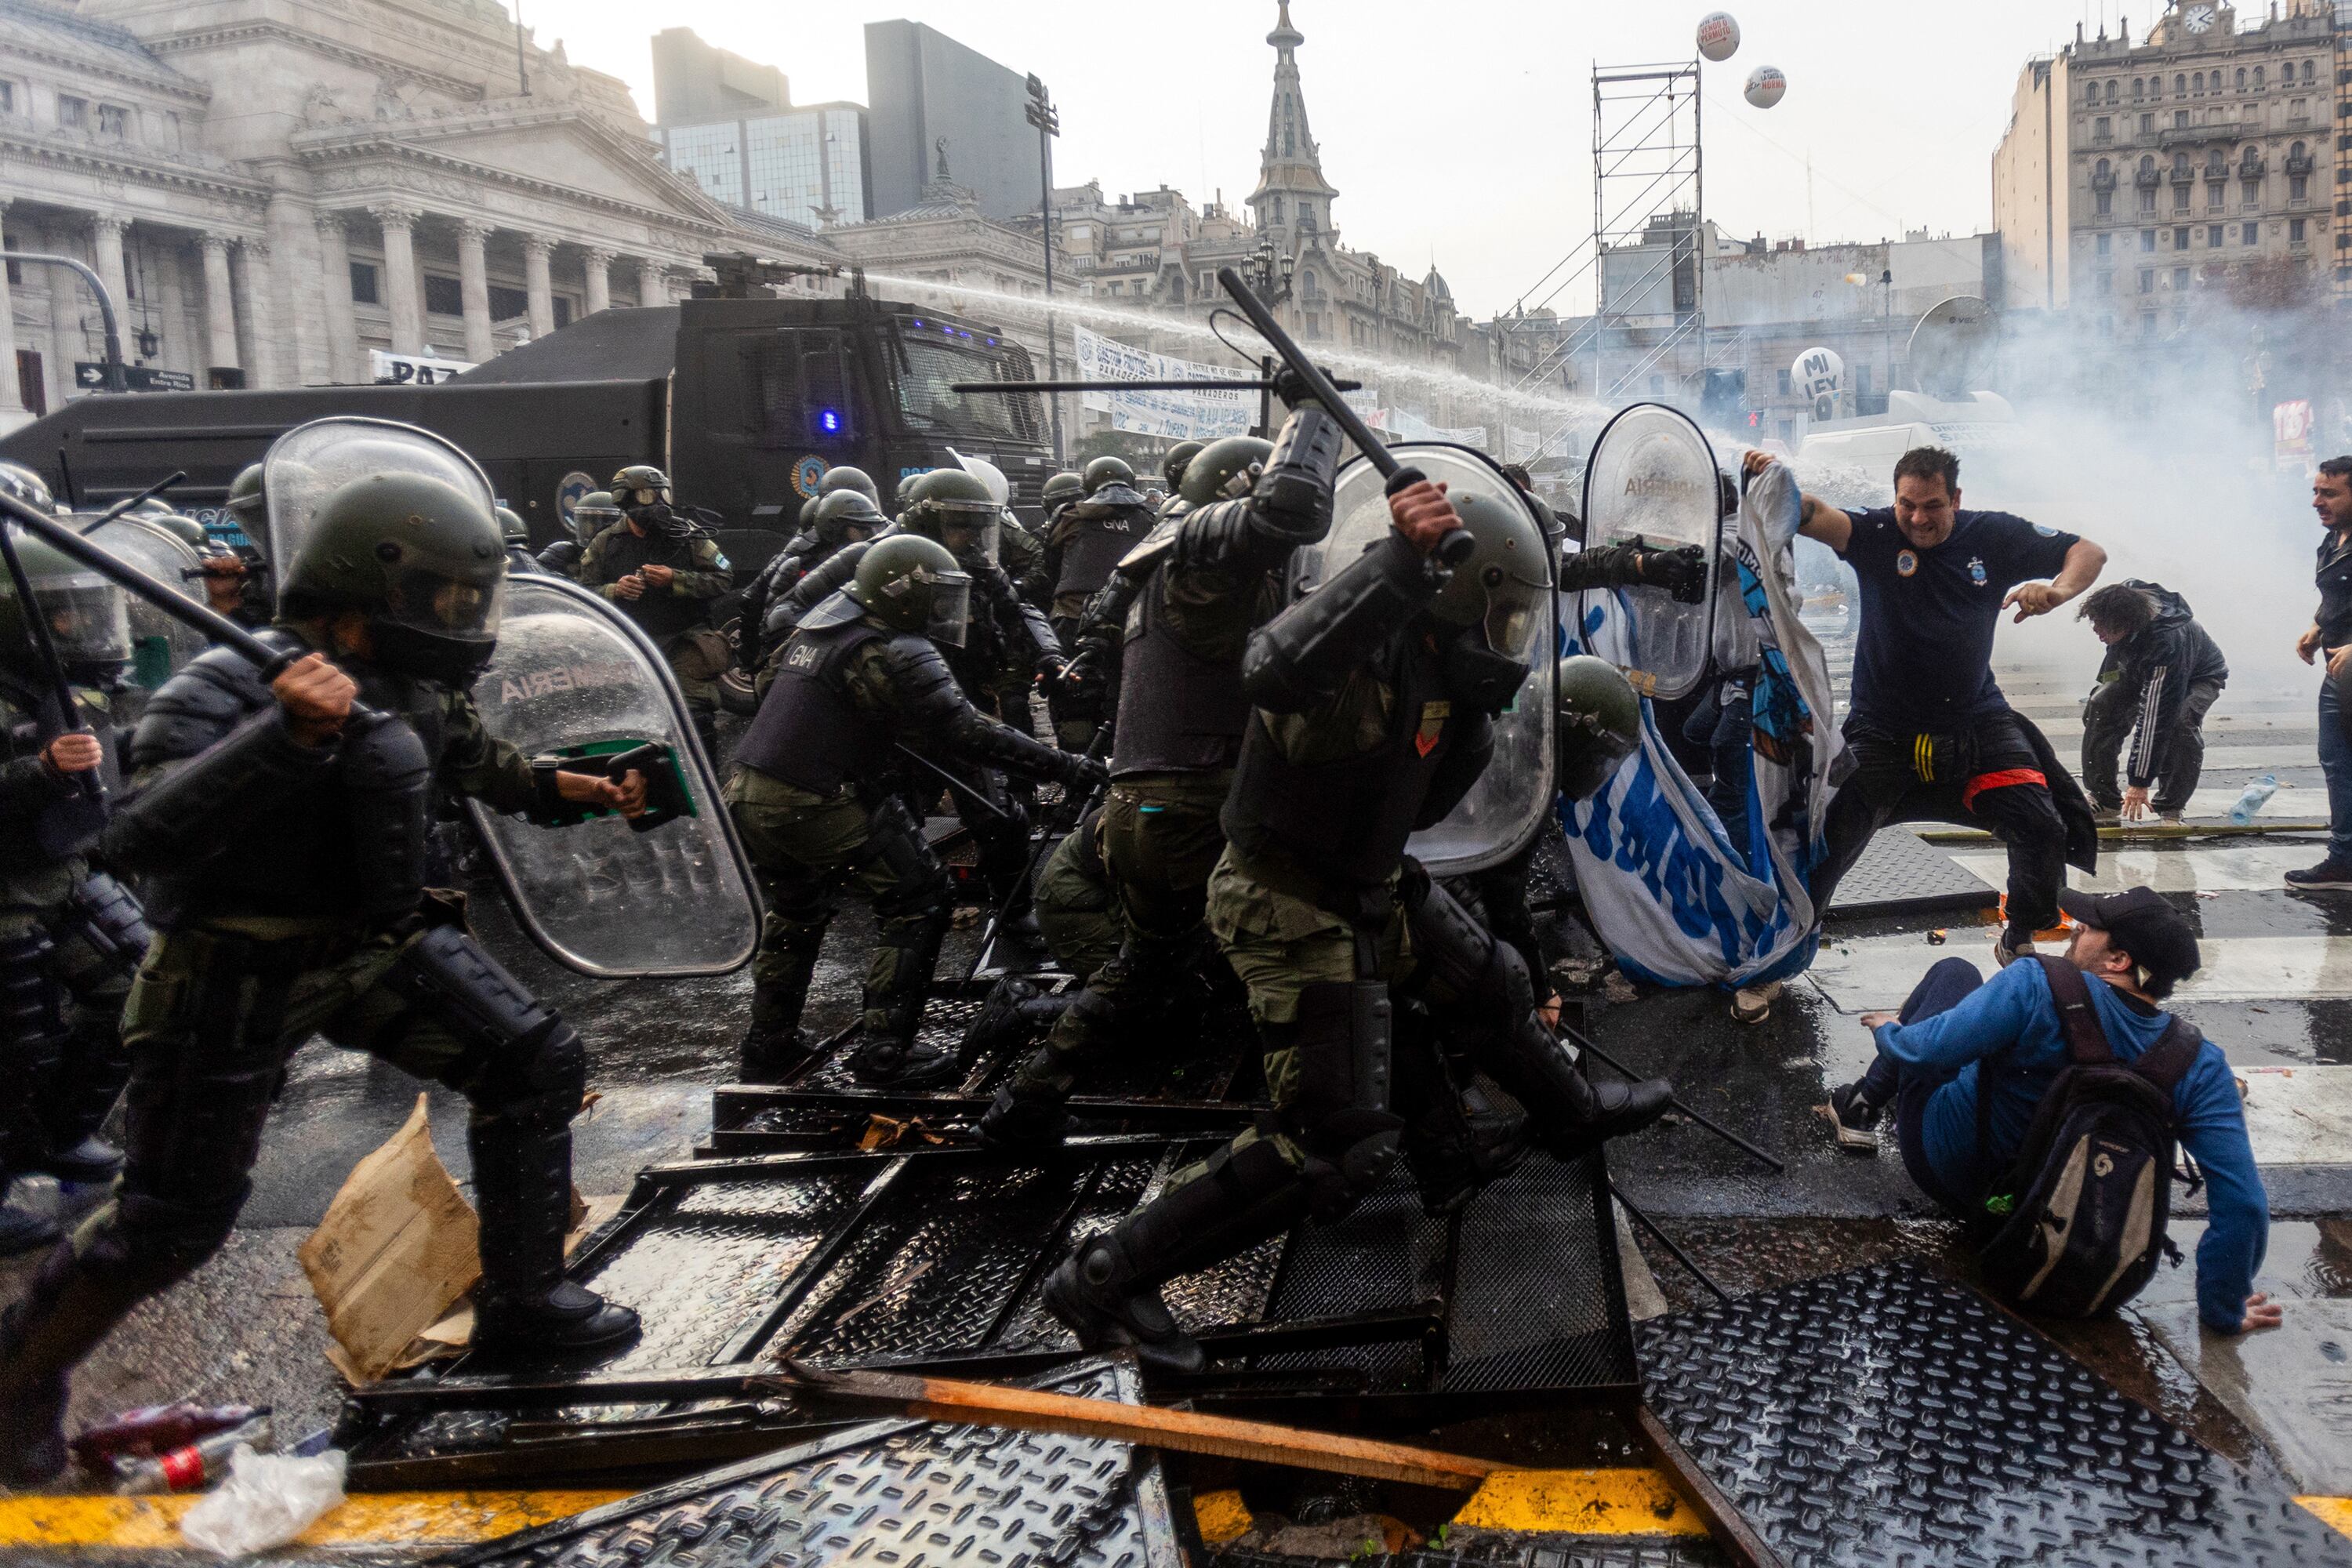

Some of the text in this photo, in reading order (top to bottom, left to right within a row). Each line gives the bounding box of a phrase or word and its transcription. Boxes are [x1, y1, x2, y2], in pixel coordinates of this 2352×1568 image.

[1099, 364, 1149, 383] PANADERO
[1804, 354, 1829, 378] MI
[150, 377, 171, 387] Entre
[158, 372, 190, 382] Avenida
[1103, 520, 1130, 532] GNA
[789, 644, 817, 669] GNA
